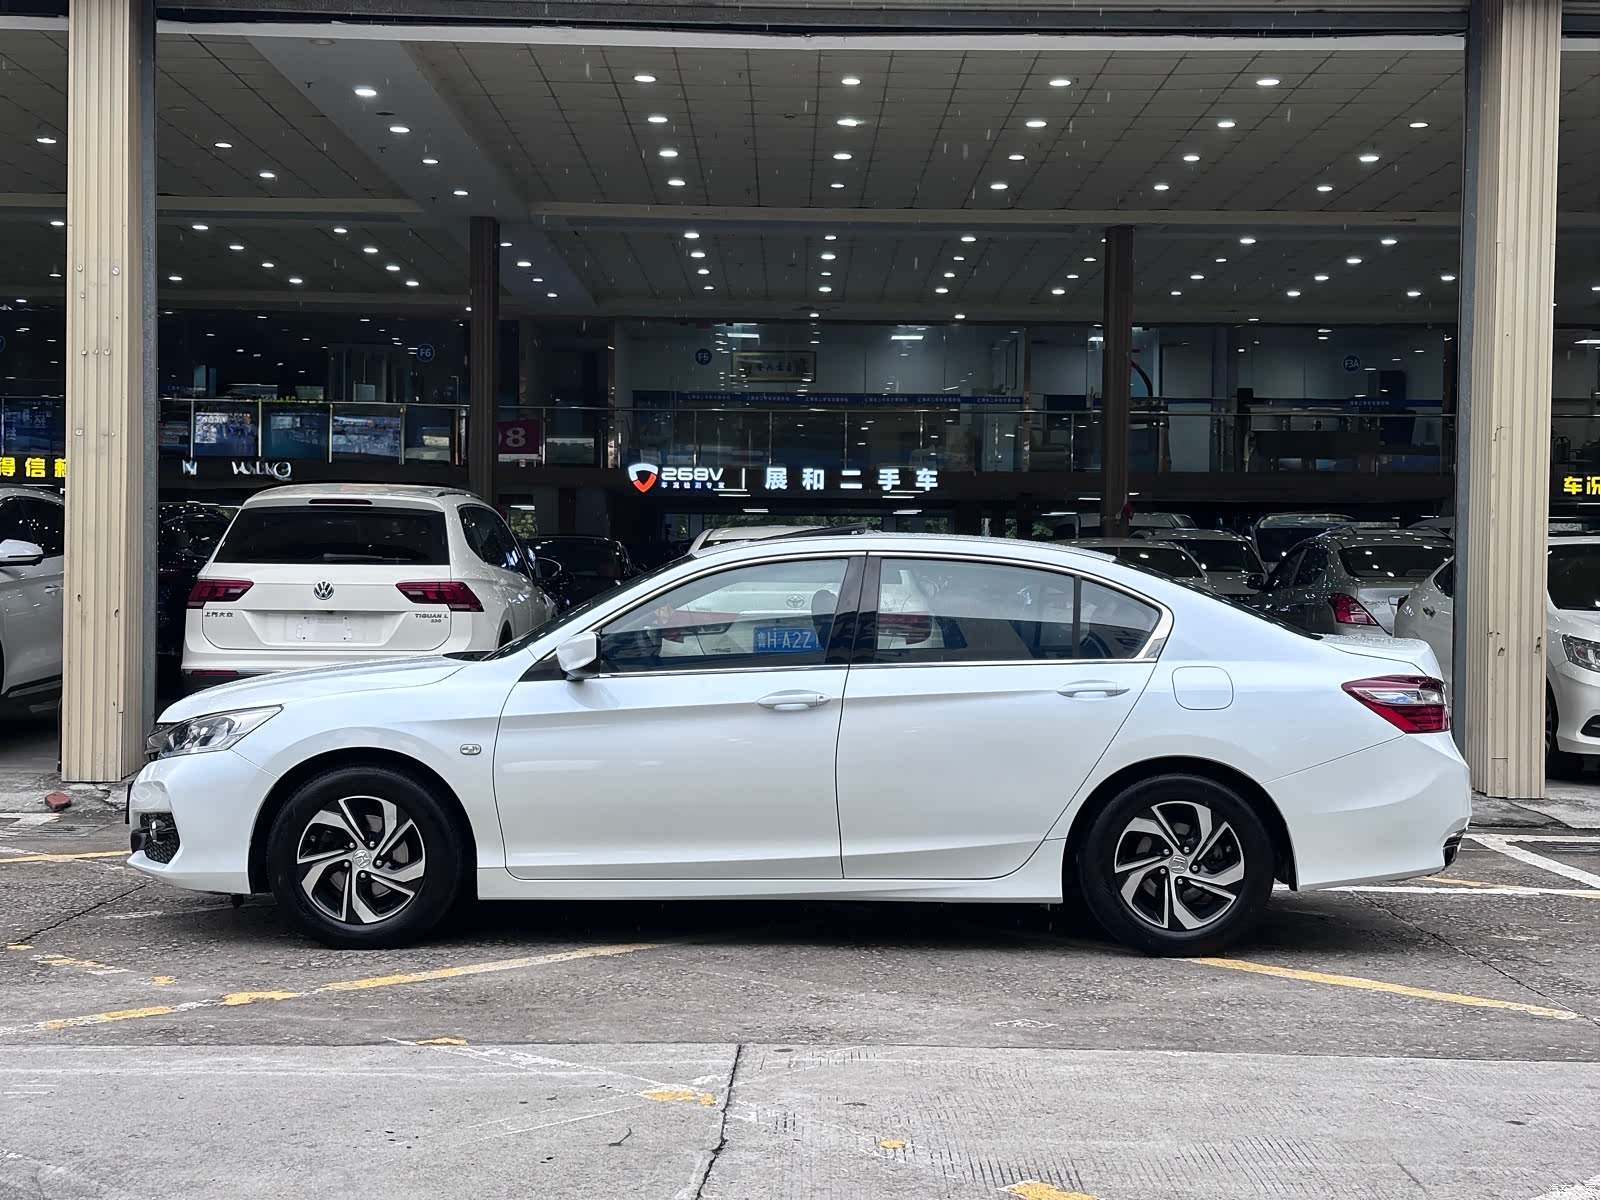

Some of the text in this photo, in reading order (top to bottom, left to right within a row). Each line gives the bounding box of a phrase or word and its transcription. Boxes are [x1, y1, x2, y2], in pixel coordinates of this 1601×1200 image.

[661, 467, 724, 481] 268V
[765, 467, 938, 491] 展和二手车
